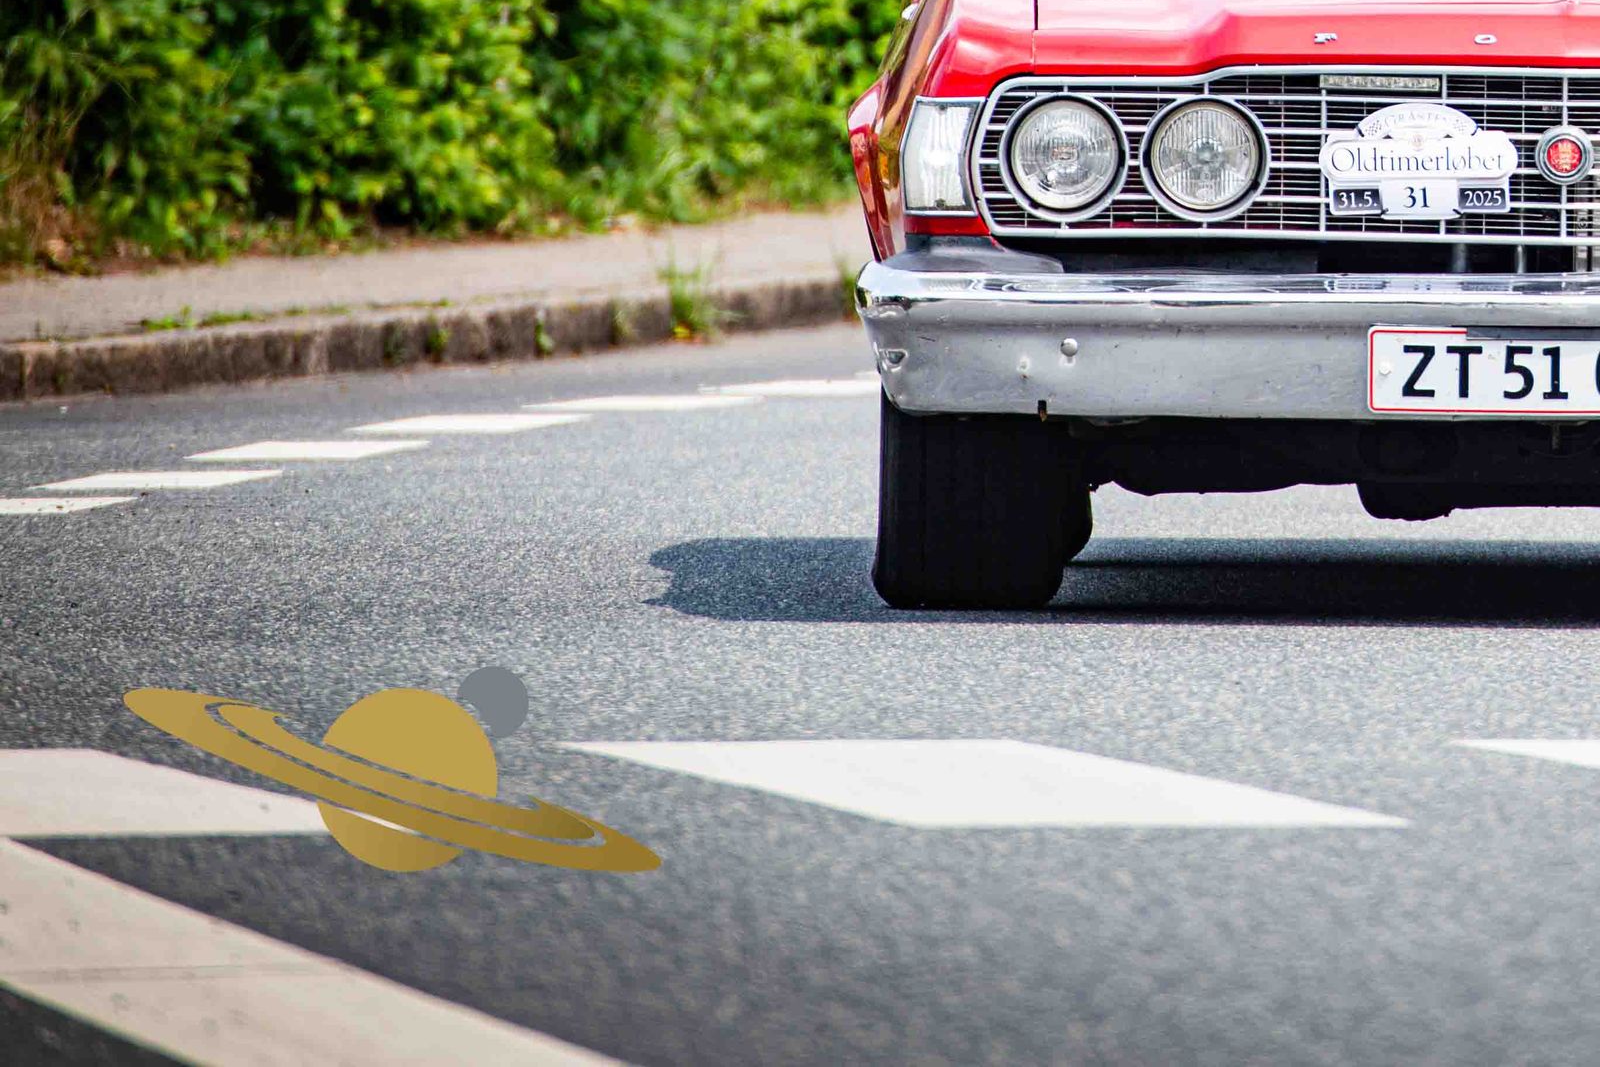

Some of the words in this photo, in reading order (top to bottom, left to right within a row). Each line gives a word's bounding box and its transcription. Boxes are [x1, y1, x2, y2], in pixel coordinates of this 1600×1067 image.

[1331, 146, 1504, 174] Oldtimerløbet
[1338, 191, 1378, 209] 31.5.
[1402, 186, 1430, 209] 31
[1464, 190, 1502, 207] 2025
[1402, 344, 1483, 398] ZT
[1503, 344, 1569, 400] 51
